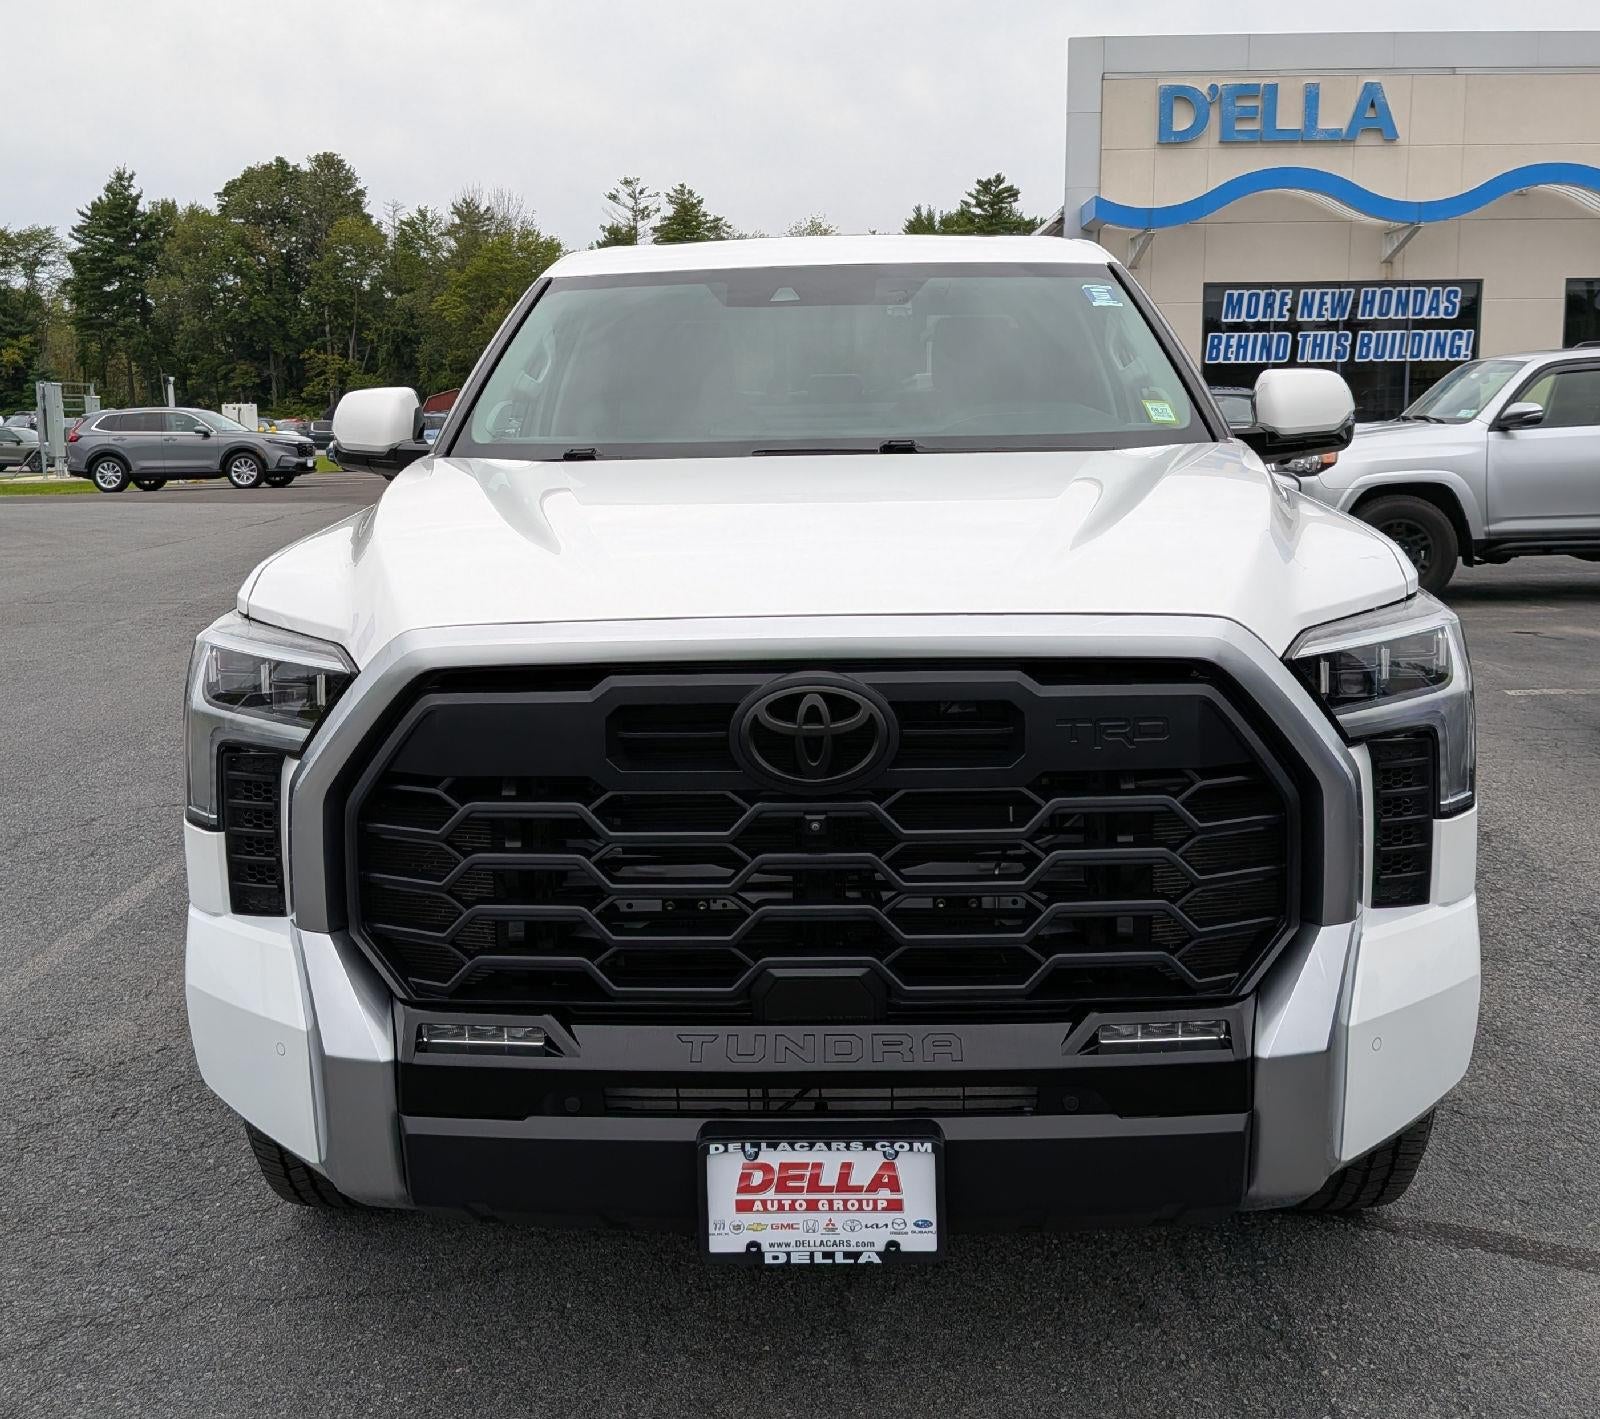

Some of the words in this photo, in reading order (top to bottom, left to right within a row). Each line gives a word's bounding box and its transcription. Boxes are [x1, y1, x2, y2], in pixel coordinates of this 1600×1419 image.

[1157, 82, 1399, 144] D'ELLA
[1222, 290, 1292, 321] MORE
[1297, 289, 1353, 320] NEW
[1357, 287, 1461, 320] HONDAS
[1206, 332, 1291, 363] BEHIND
[1297, 330, 1352, 361] THIS
[1355, 329, 1474, 361] BUILDING!
[1056, 717, 1169, 750] TRD
[677, 1033, 963, 1064] TUNDRA
[709, 1141, 932, 1155] DELLACARS.COM
[736, 1161, 904, 1195] DELLA
[752, 1199, 807, 1212] AUTO
[817, 1199, 888, 1212] GROUP
[770, 1222, 800, 1231] GMC
[764, 1251, 882, 1264] DELLA
[768, 1239, 876, 1249] www.DELLACARS.com
